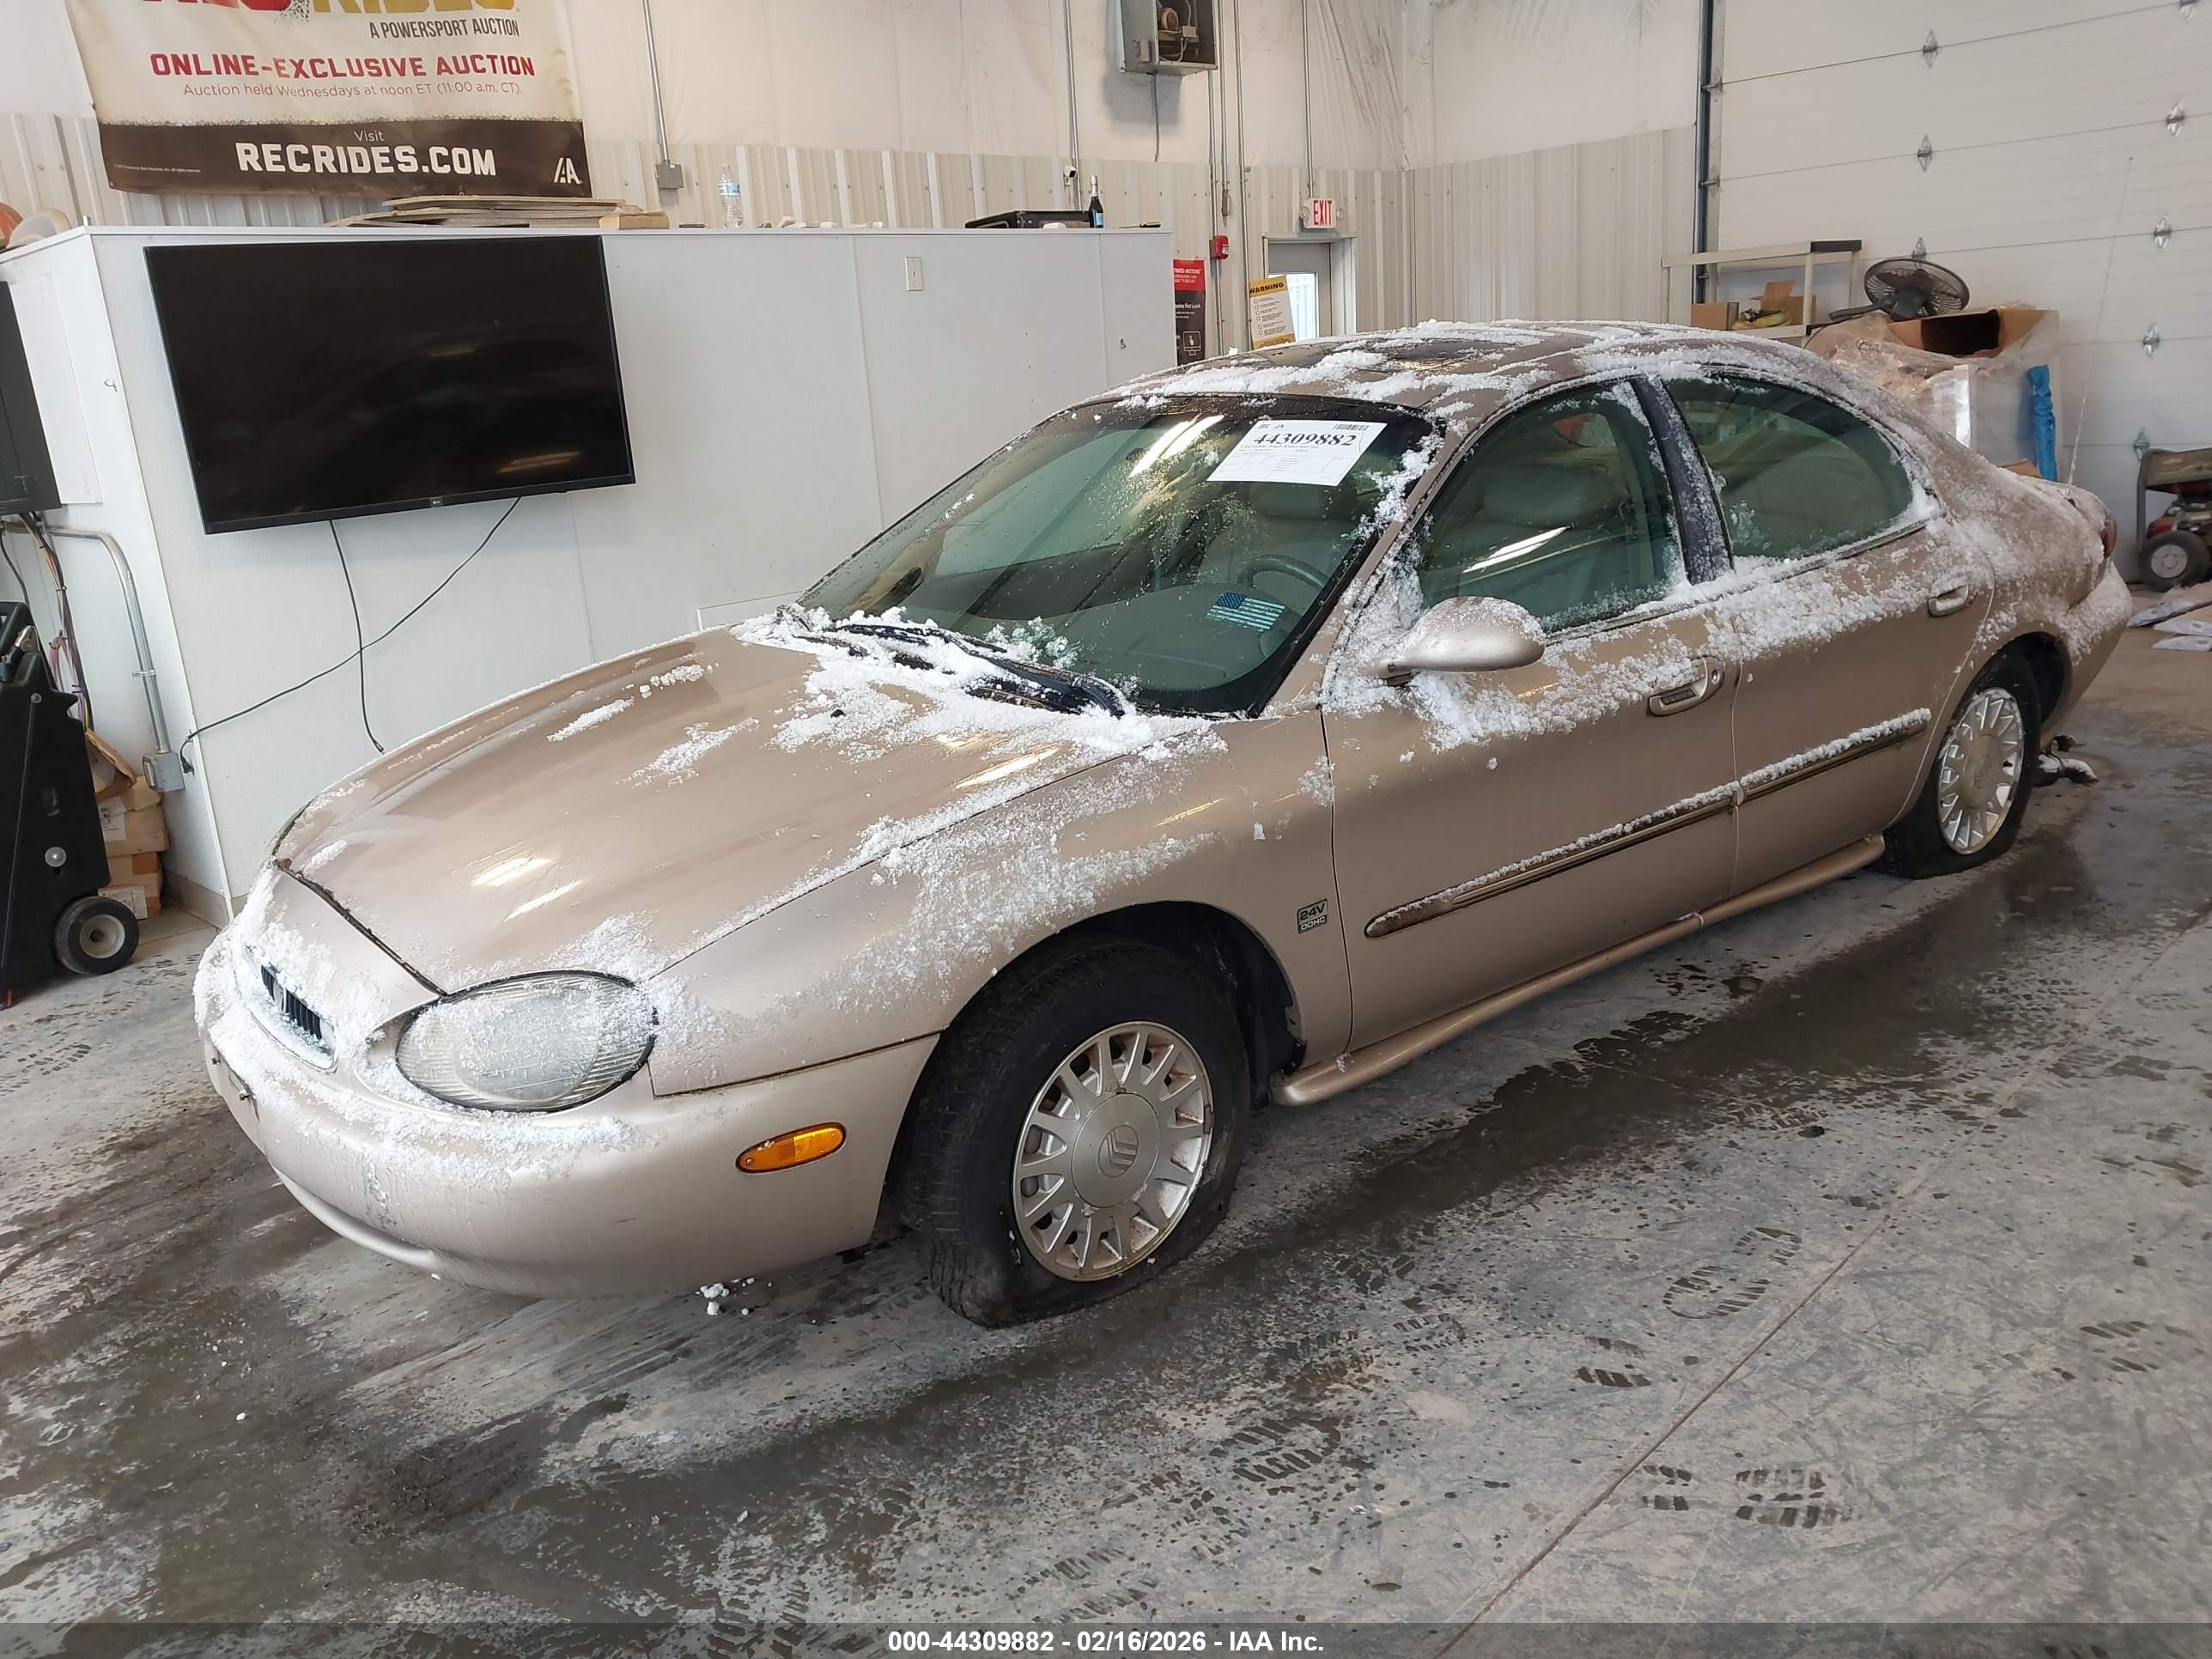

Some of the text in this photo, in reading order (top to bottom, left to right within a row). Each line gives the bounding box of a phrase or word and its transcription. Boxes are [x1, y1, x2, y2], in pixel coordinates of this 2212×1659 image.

[369, 17, 520, 39] A POWERSPORT AUCTION
[150, 53, 536, 79] ONLINE-EXCLUSIVE AUCTION
[184, 82, 523, 98] Auction held Wednesdays at noon ET (11:00 a.m. CT).
[353, 130, 386, 143] Visit
[234, 143, 496, 176] RECRIDES.COM
[1313, 198, 1333, 227] EXIT
[1249, 282, 1285, 295] WARNING
[1254, 432, 1357, 447] 44309882
[1300, 902, 1326, 921] 24V
